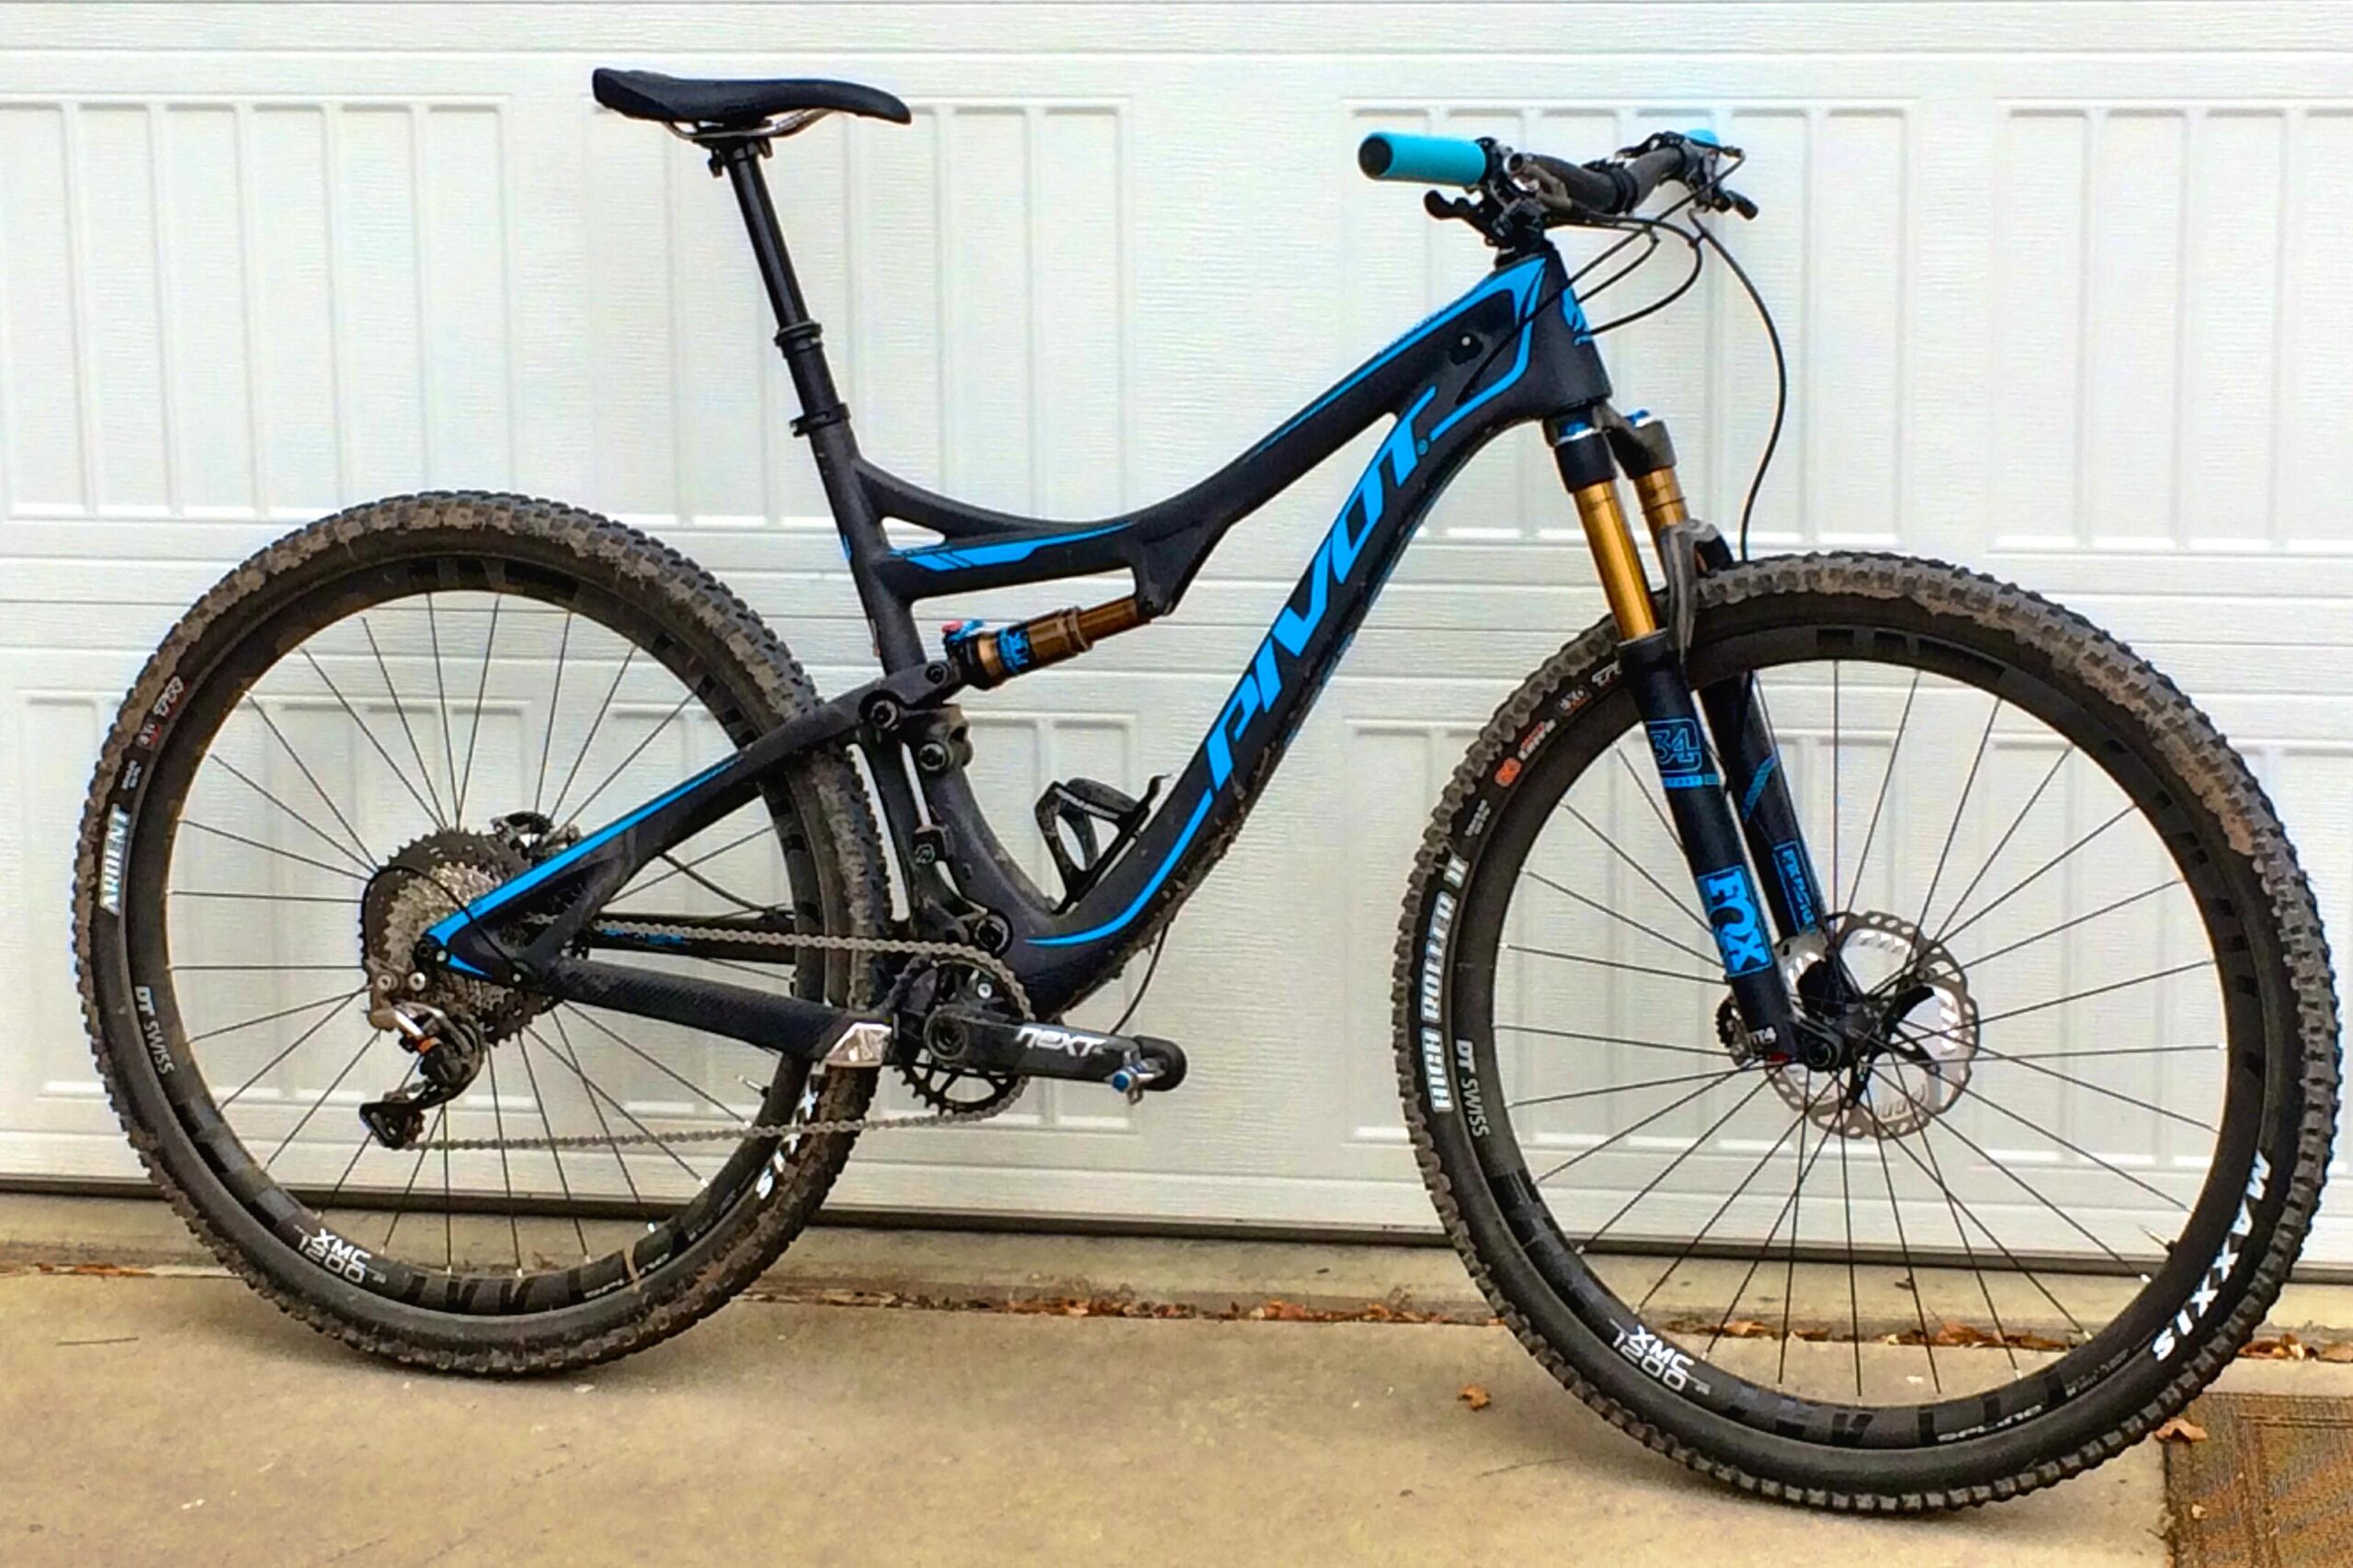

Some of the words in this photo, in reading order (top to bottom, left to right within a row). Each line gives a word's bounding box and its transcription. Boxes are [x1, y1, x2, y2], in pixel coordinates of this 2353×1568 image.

[1206, 385, 1437, 791] PIVOT
[1650, 728, 1700, 765] 34
[99, 802, 131, 915] ARDENT
[1707, 870, 1768, 972] FOX
[1420, 891, 1458, 1024] ROLLER
[134, 985, 155, 1017] DT
[143, 1020, 175, 1074] SWISS
[1421, 1027, 1455, 1113] HIGH
[1456, 1039, 1477, 1074] DT
[1461, 1077, 1491, 1138] SWISS
[298, 1234, 367, 1284] 1200
[311, 1227, 372, 1269] XMC
[2152, 1149, 2272, 1361] MAXXIS
[1612, 1332, 1688, 1392] 1200
[1629, 1324, 1695, 1378] XMC
